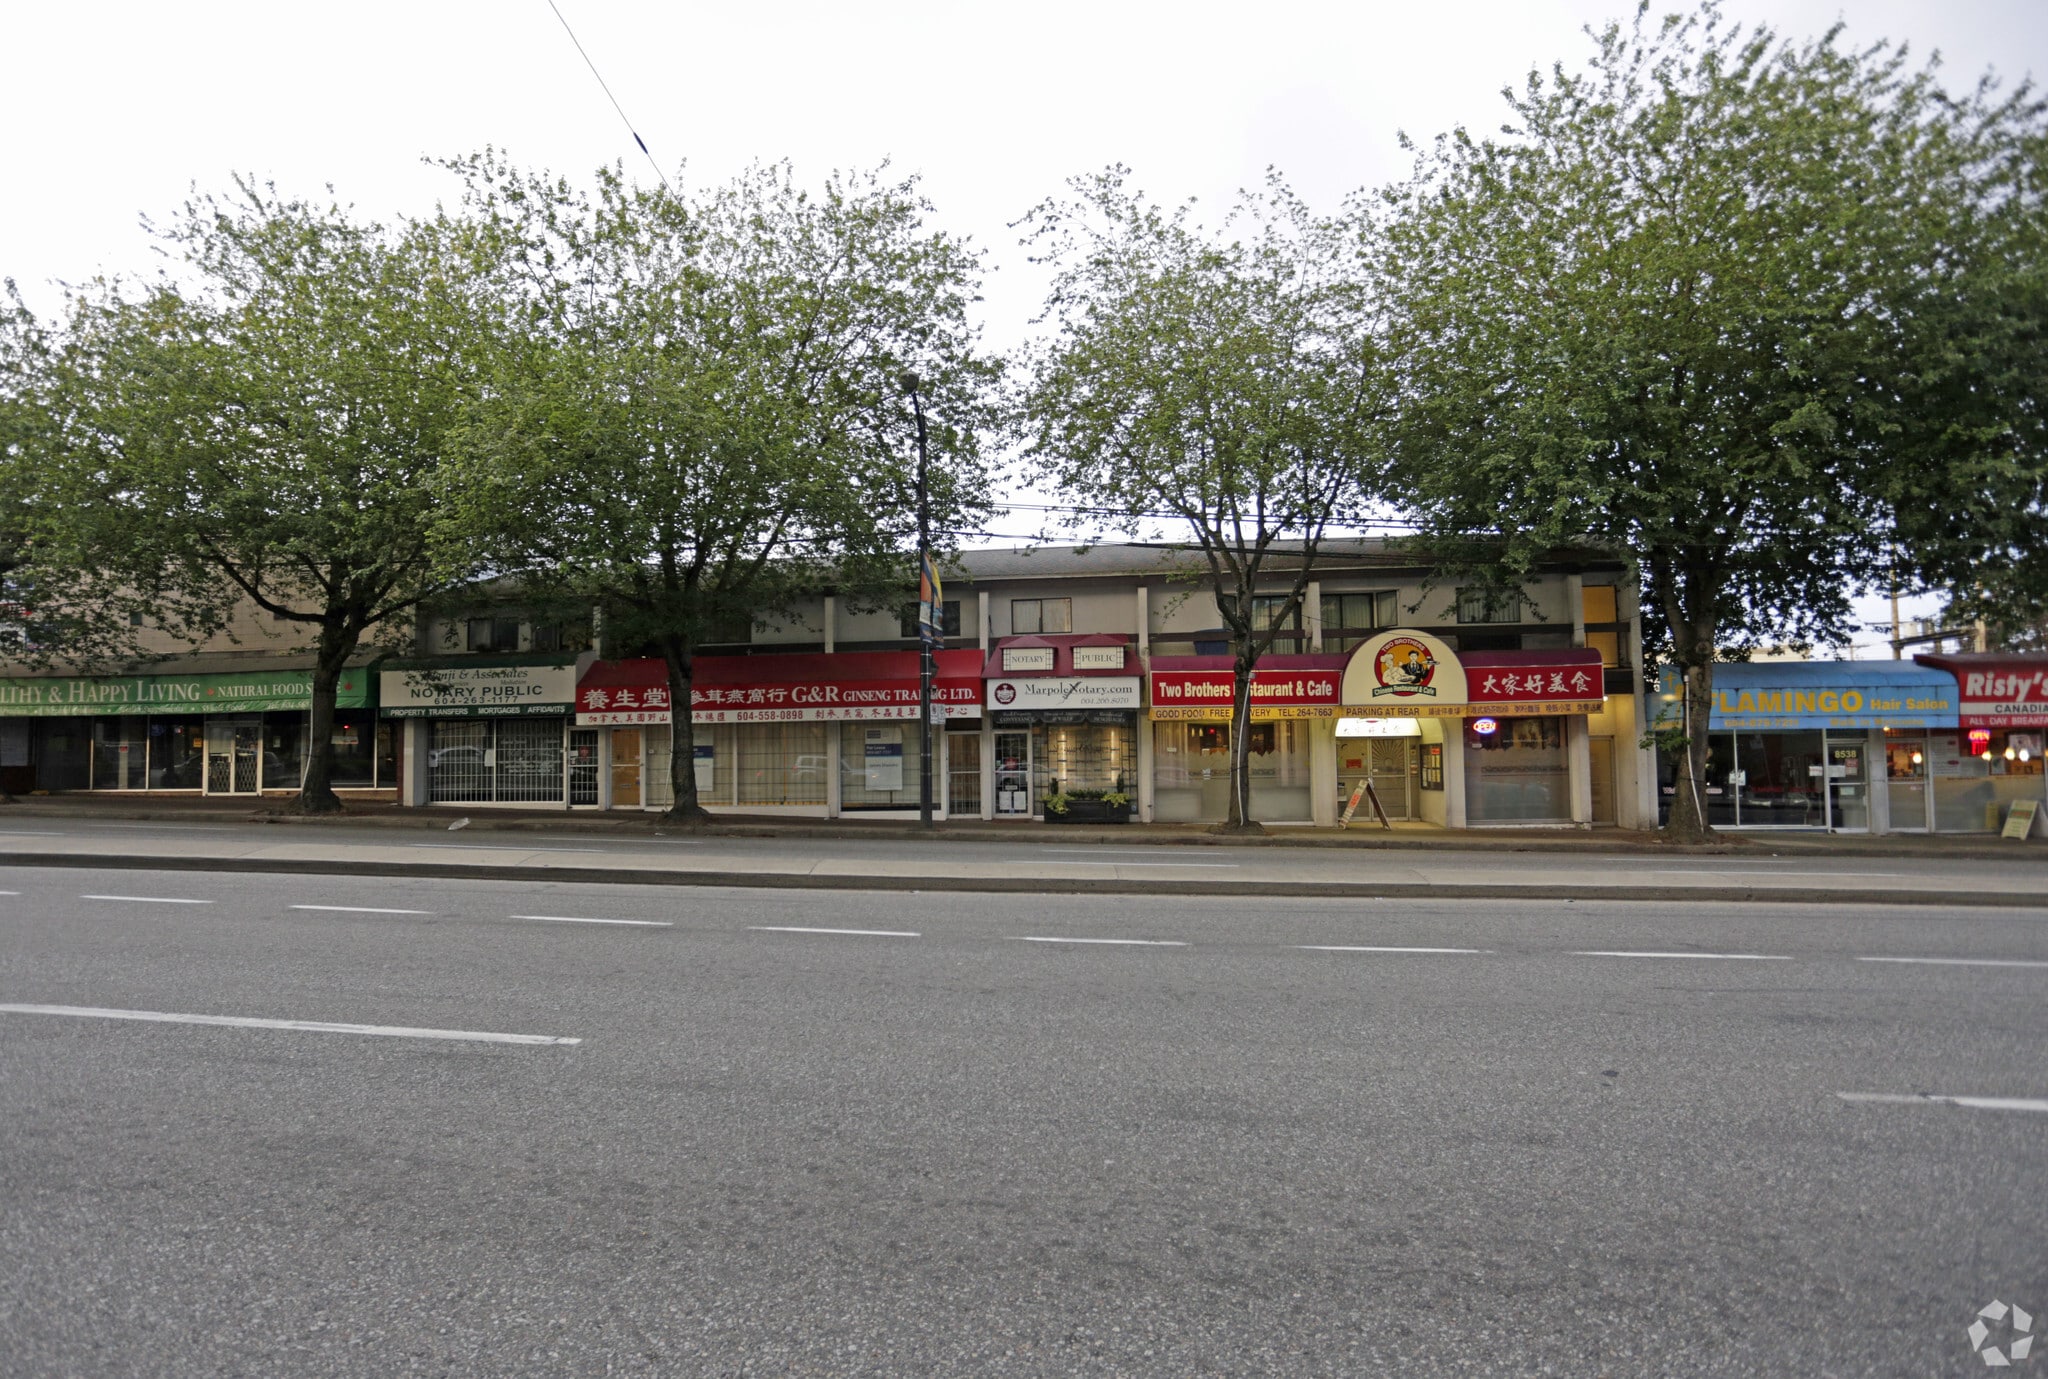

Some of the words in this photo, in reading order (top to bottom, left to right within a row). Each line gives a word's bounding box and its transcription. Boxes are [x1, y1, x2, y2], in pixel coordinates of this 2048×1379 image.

[1382, 641, 1394, 652] TWO
[1394, 639, 1426, 652] BROTHERS
[1012, 655, 1044, 664] NOTARY
[1081, 654, 1116, 663] PUBLIC
[459, 670, 467, 679] &
[1483, 671, 1592, 695] 大家好美食
[50, 686, 63, 703] &
[68, 681, 131, 703] HAPPY
[136, 680, 200, 702] LIVING
[218, 686, 269, 698] NATURAL
[273, 683, 303, 696] FOOD
[411, 687, 476, 698] NOTARY
[482, 685, 543, 696] PUBLIC
[1159, 682, 1181, 697] Two
[1185, 681, 1230, 697] Brothers
[1234, 680, 1293, 697] staurant
[1296, 681, 1305, 696] &
[1307, 680, 1333, 696] Cafe
[792, 685, 840, 703] G&R
[843, 689, 891, 702] GINSENG
[950, 688, 976, 700] LTD.
[434, 696, 518, 705] 604-263-1177
[583, 688, 669, 710] 養生堂
[1871, 698, 1901, 710] Hair
[1906, 698, 1948, 710] Salon
[390, 709, 425, 717] PROPERTY
[429, 708, 468, 716] TRANSFERS
[478, 707, 520, 715] MORTGAGES
[527, 706, 566, 714] AFFIDAVITS
[1156, 710, 1180, 718] GOOD
[1210, 709, 1230, 717] FREE
[1297, 708, 1333, 717] 264-7663
[1346, 708, 1383, 716] PARKING
[1398, 707, 1420, 715] REAR
[736, 710, 804, 721] 604-558-0898
[1969, 717, 1984, 725] ALL
[1989, 717, 2007, 725] DAY
[1473, 722, 1496, 731] OPEN
[1969, 730, 1991, 740] OPEN
[1834, 750, 1856, 759] 8538
